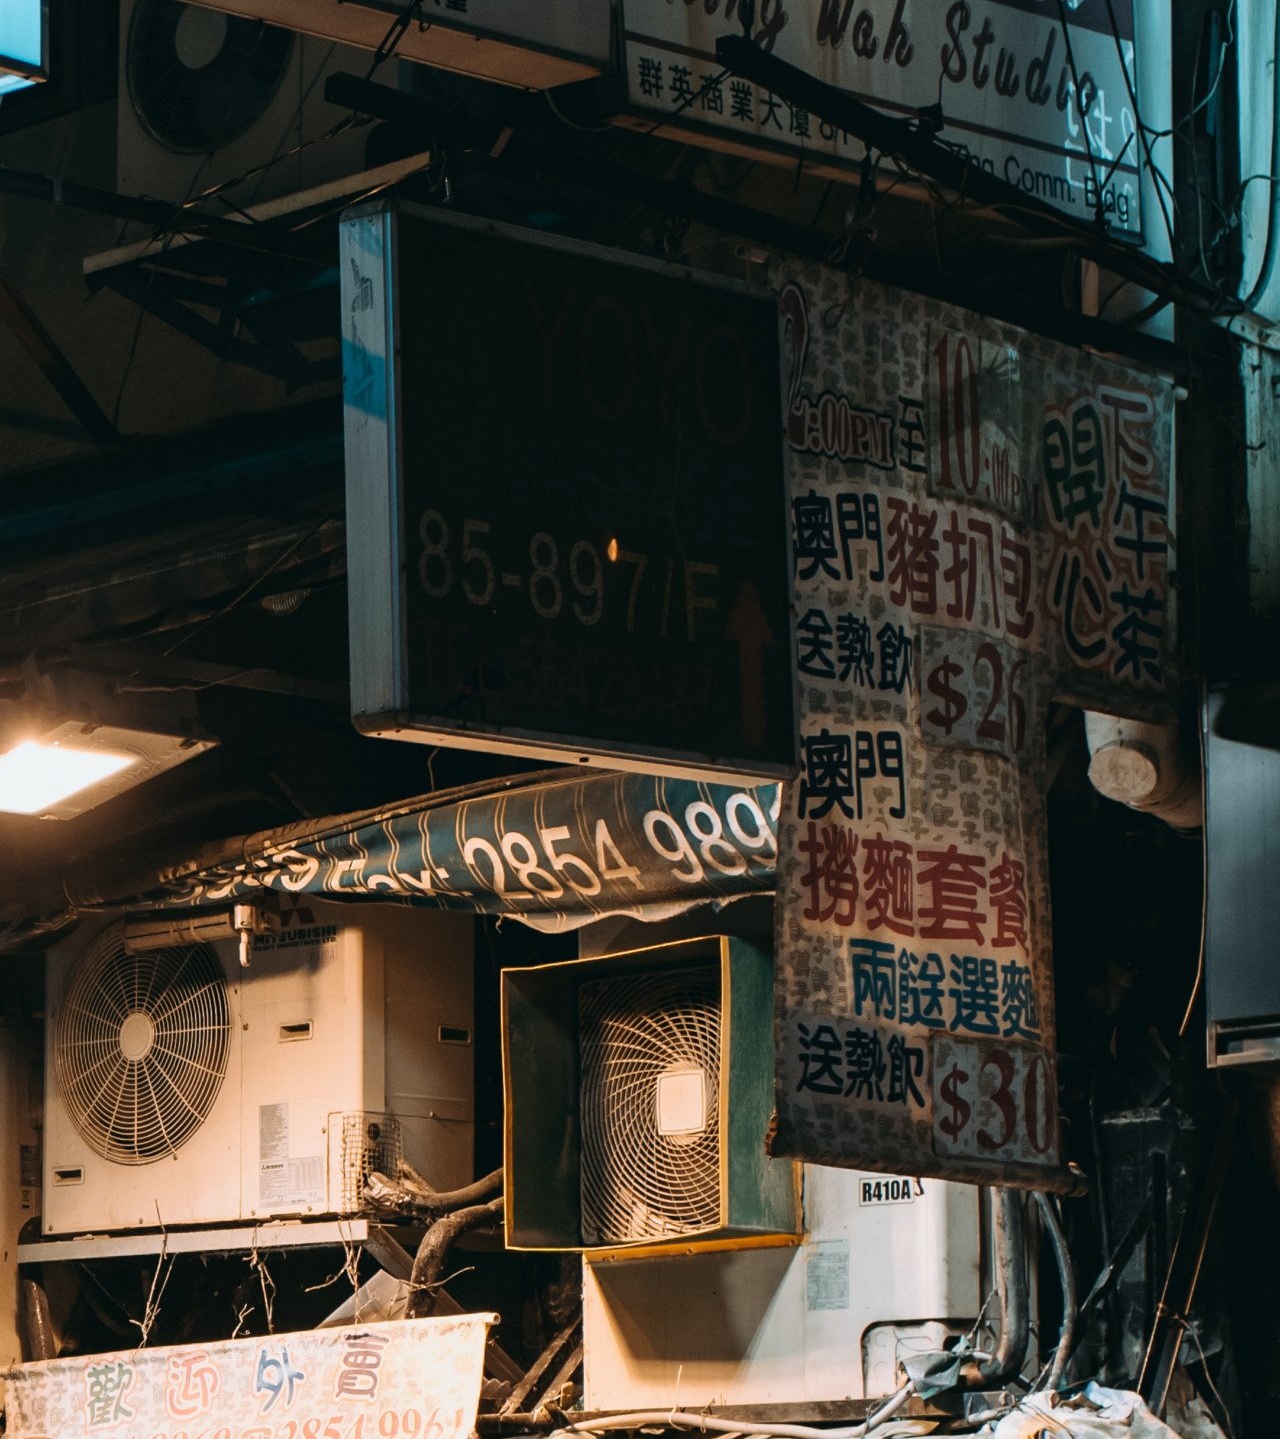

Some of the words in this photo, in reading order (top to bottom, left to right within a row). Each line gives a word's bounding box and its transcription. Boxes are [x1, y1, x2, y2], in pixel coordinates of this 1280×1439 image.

[638, 56, 812, 140] 群英商業大廈
[942, 0, 1100, 117] Studio
[1004, 155, 1076, 205] Comm.
[526, 279, 753, 446] YOYO
[797, 608, 913, 695] 送熱飲
[925, 642, 1027, 755] $26
[798, 728, 907, 821] 澳門
[463, 818, 642, 902] 2854
[643, 791, 781, 883] 989
[798, 821, 1031, 957] 撈麵套餐
[253, 925, 337, 946] MITSUBISHI
[796, 1022, 925, 1108] 送熱飲
[939, 1047, 1058, 1155] $30
[861, 1178, 913, 1202] R410A
[81, 1330, 393, 1434] 歡迎外賣
